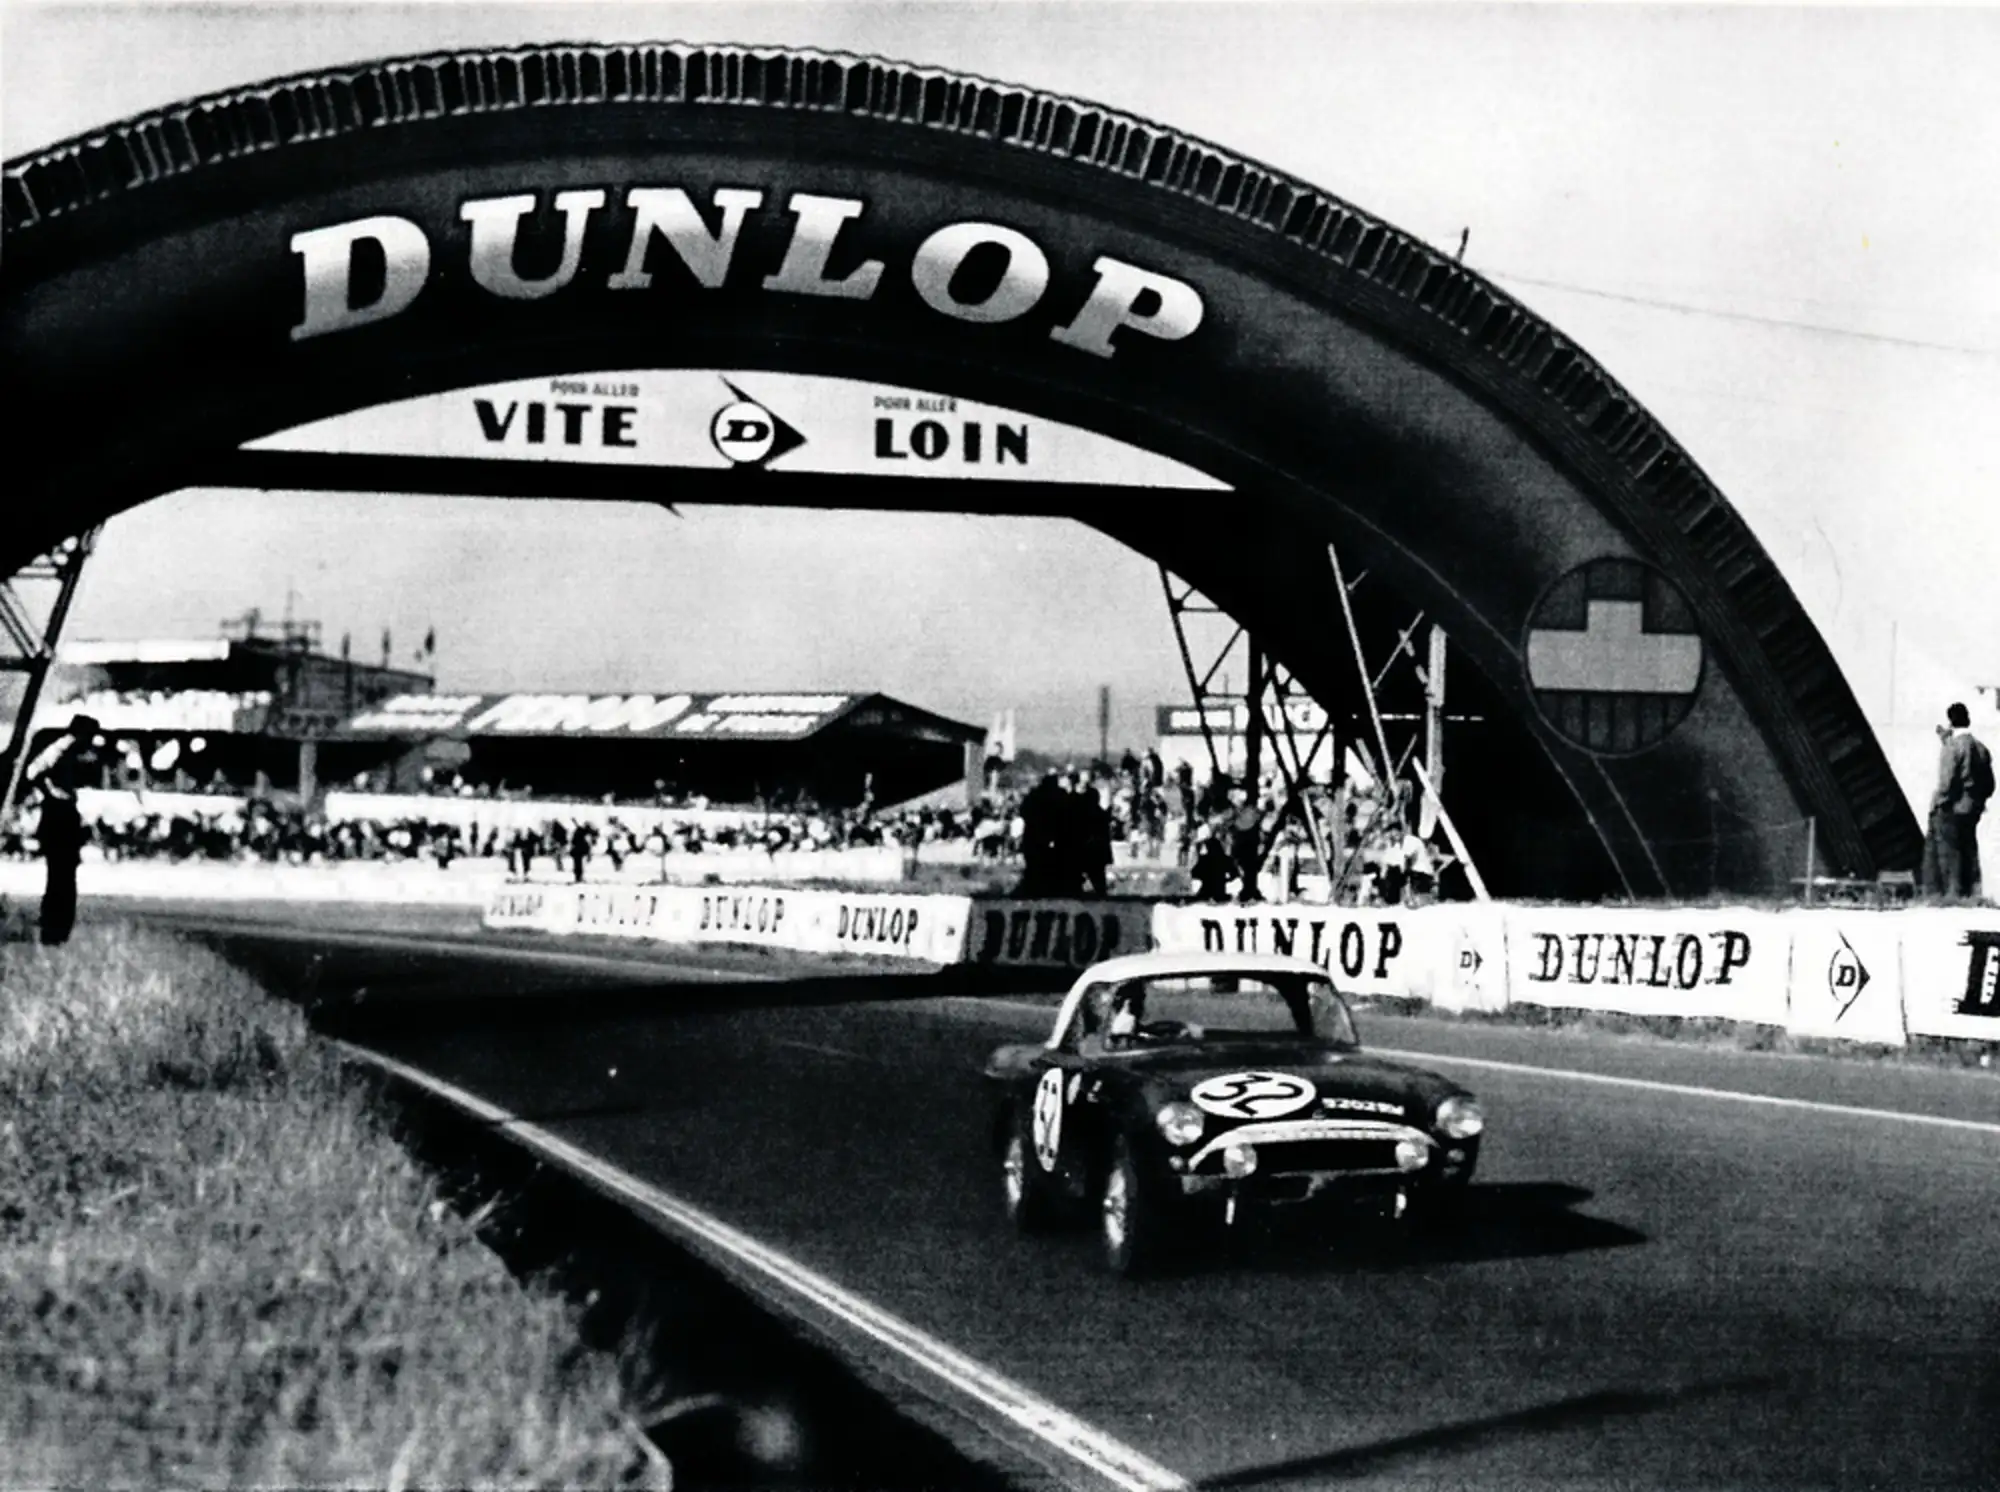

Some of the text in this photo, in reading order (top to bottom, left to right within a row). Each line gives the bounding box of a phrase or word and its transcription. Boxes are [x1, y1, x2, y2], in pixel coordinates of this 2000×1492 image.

[290, 187, 1204, 358] DUNLOP
[474, 400, 638, 447] VITE
[721, 419, 770, 442] D
[875, 418, 1028, 464] LOIN
[699, 896, 784, 933] DUNLOP
[836, 904, 919, 944] DUNLOP
[1200, 918, 1403, 979] DUNLOP
[1459, 950, 1473, 969] D
[1528, 930, 1752, 990] DUNLOP
[1835, 964, 1857, 987] D
[1199, 1073, 1305, 1116] 32
